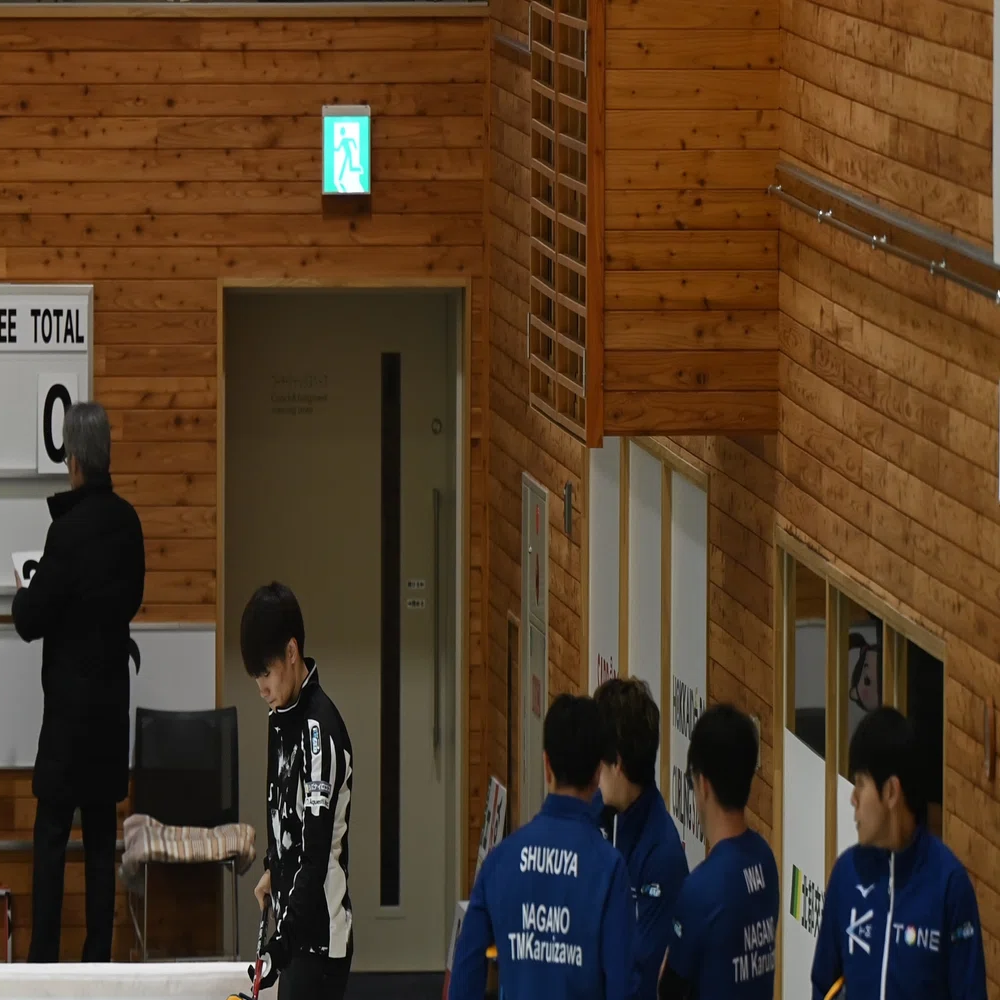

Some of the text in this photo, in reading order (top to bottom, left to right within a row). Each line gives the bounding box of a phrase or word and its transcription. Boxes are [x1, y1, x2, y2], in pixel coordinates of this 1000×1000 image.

[31, 308, 85, 343] TOTAL
[520, 846, 578, 878] SHUKUYA
[743, 863, 766, 894] IWAI
[522, 903, 570, 934] NAGANO
[732, 954, 749, 984] TM
